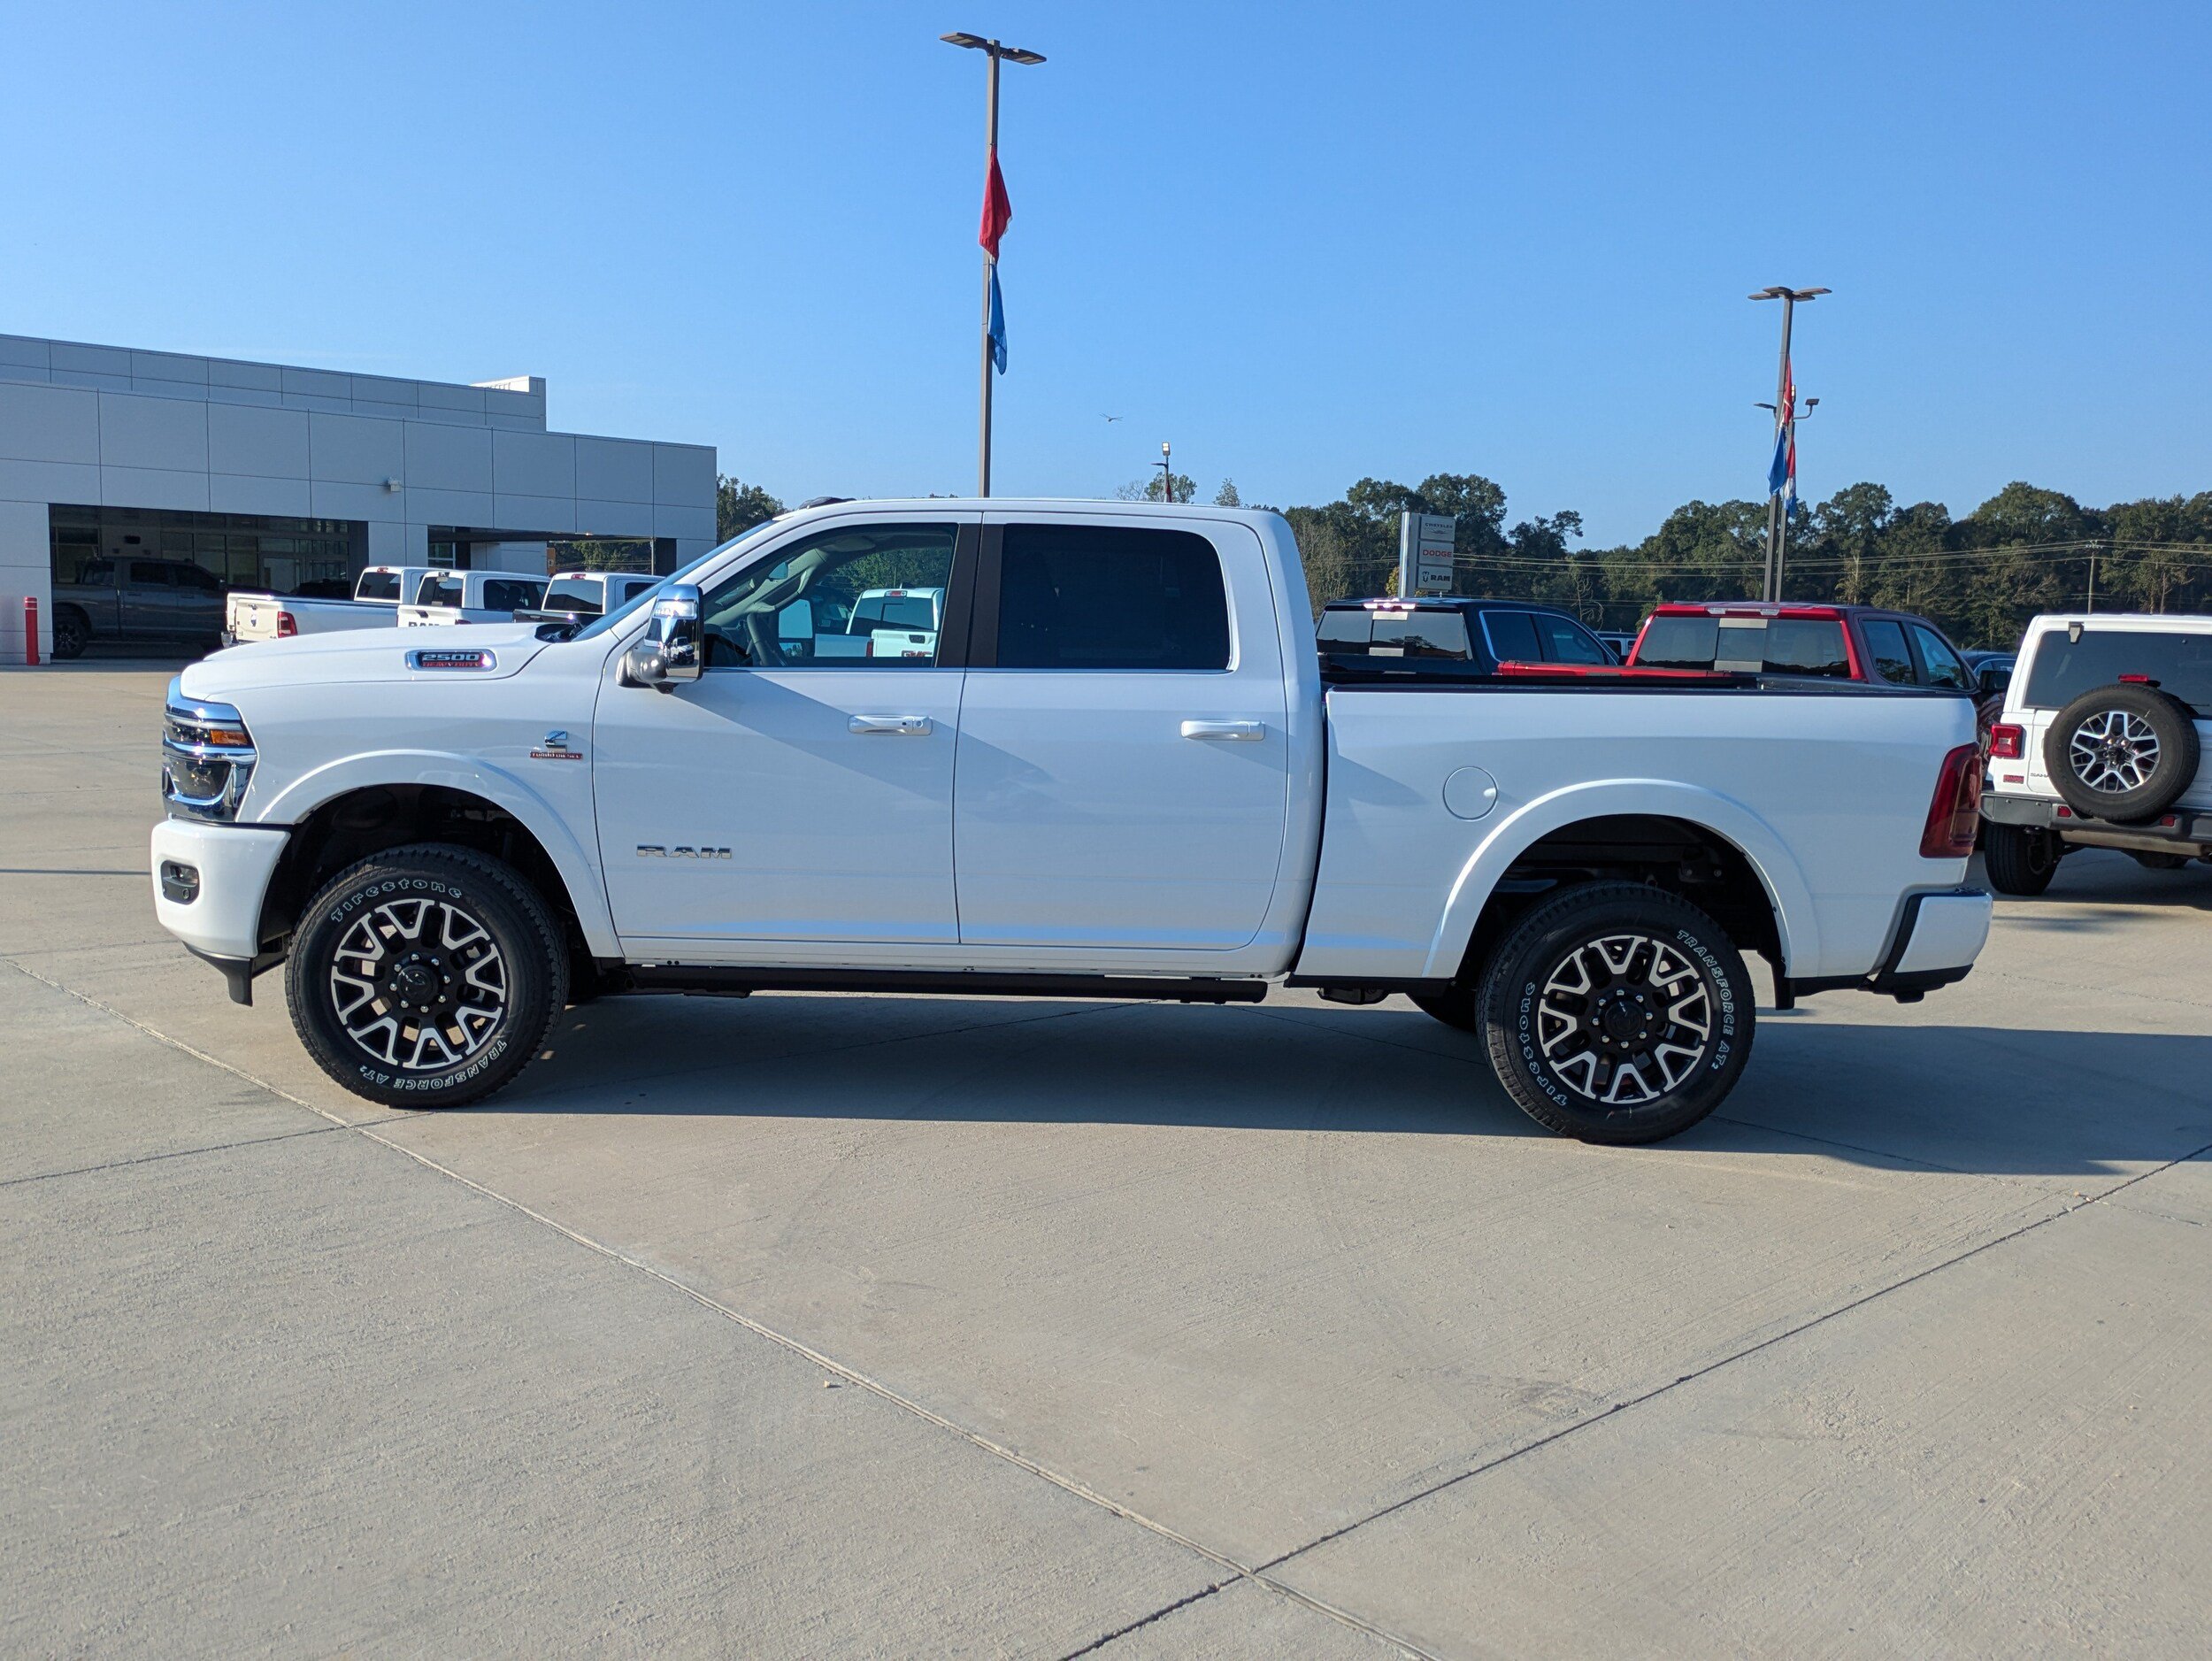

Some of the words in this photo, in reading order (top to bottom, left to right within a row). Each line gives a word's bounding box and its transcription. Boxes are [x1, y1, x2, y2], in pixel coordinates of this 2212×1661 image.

[1422, 549, 1452, 558] DODGE
[1430, 573, 1451, 582] RAM
[636, 845, 733, 860] RAM
[330, 879, 463, 924] Firestone
[1676, 928, 1735, 1037] TRANSFORCE
[394, 1039, 509, 1091] TRANSFORCE
[1518, 981, 1567, 1106] Firestone
